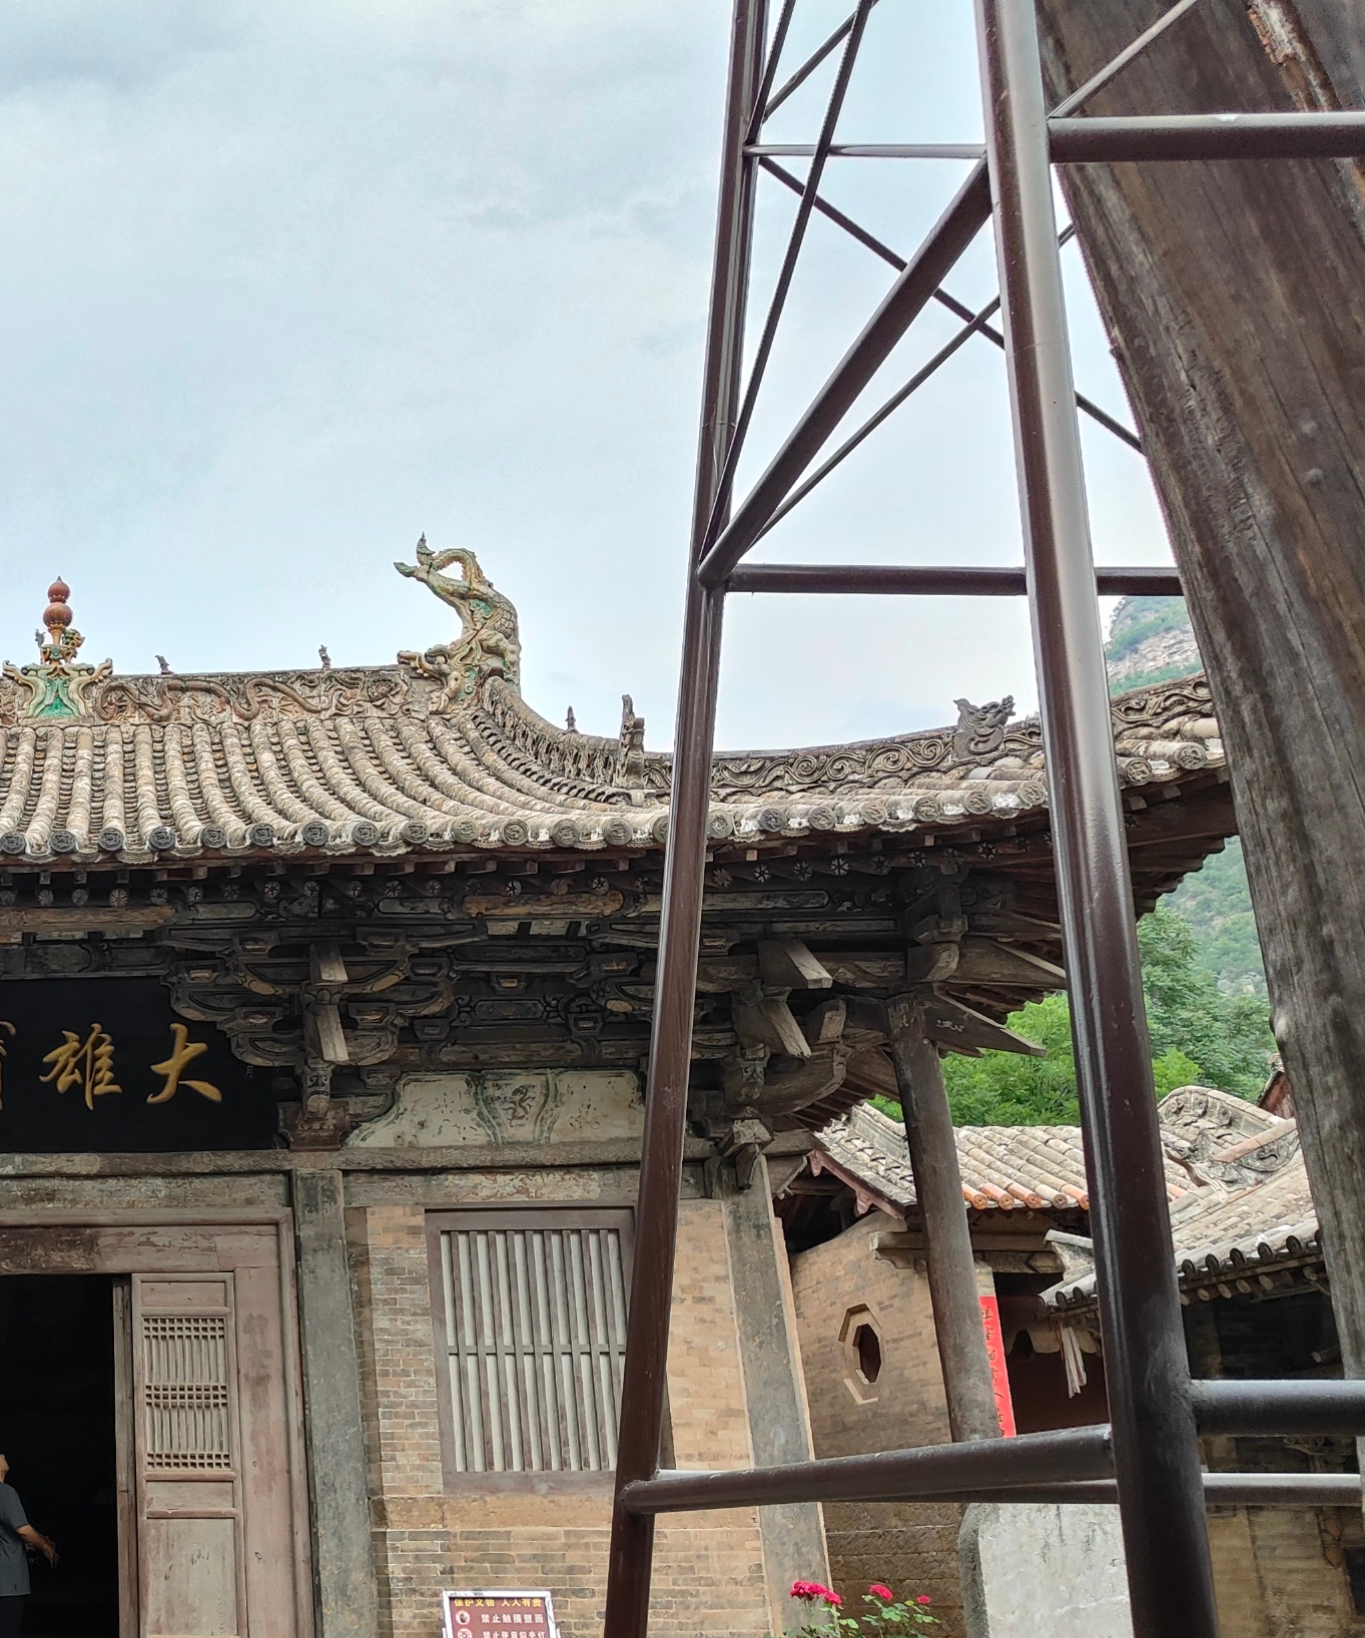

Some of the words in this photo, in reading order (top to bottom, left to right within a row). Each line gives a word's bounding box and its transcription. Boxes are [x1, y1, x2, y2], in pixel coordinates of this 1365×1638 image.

[454, 1599, 495, 1608] 保护文物
[481, 1613, 544, 1624] 禁止触摸壁画
